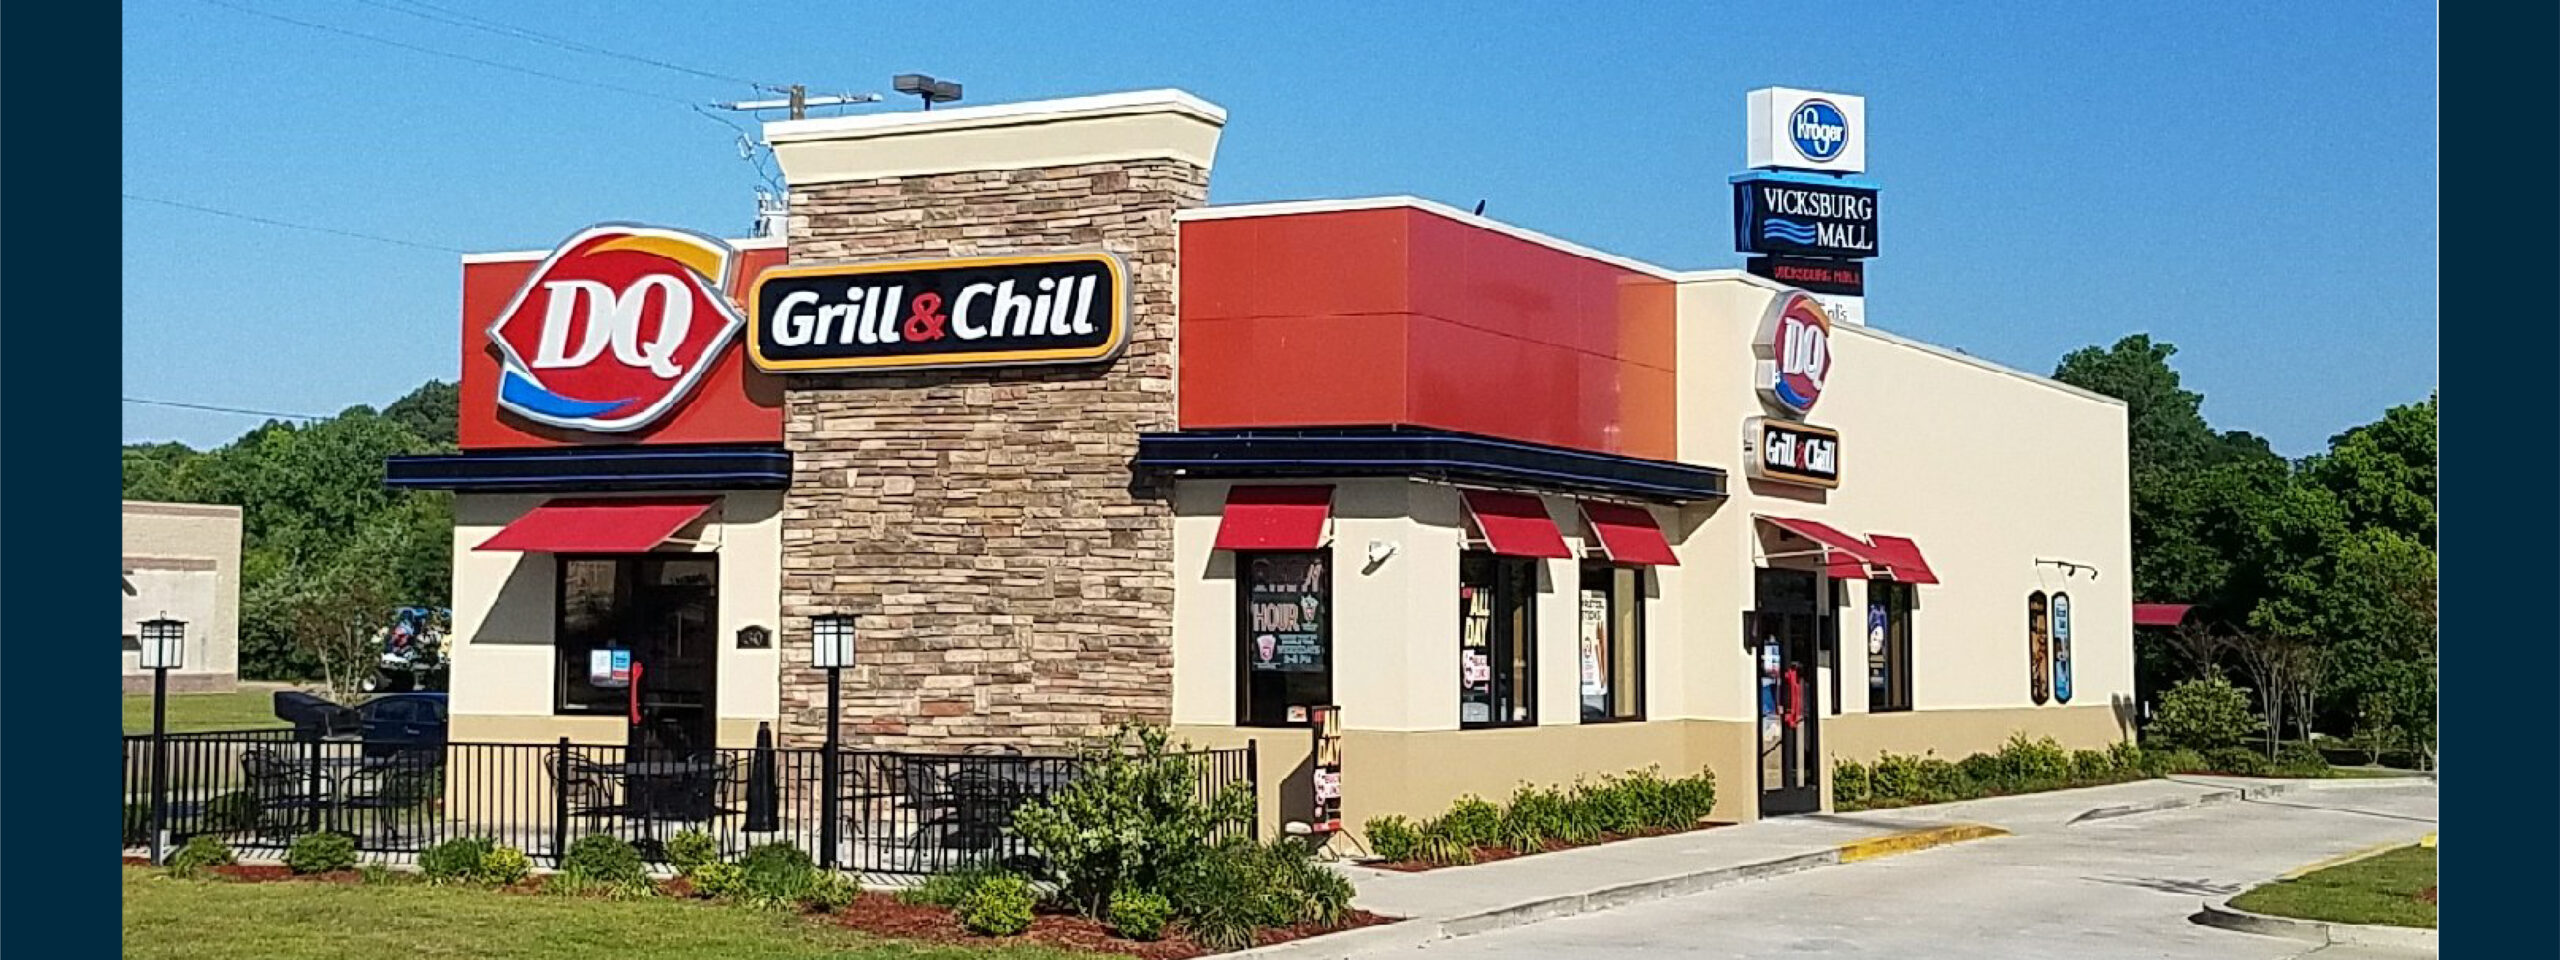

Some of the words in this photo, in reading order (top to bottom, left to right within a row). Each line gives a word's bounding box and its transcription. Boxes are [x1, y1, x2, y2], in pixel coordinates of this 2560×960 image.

[1797, 107, 1843, 154] Kroger
[1764, 187, 1873, 220] VICKSBURG
[1816, 222, 1873, 250] MALL
[532, 273, 693, 379] DQ
[1783, 316, 1825, 391] DQ
[1252, 602, 1300, 632] HOUR
[1469, 587, 1490, 616] ALL
[1464, 616, 1488, 647] DAY
[1317, 738, 1340, 767] DAY
